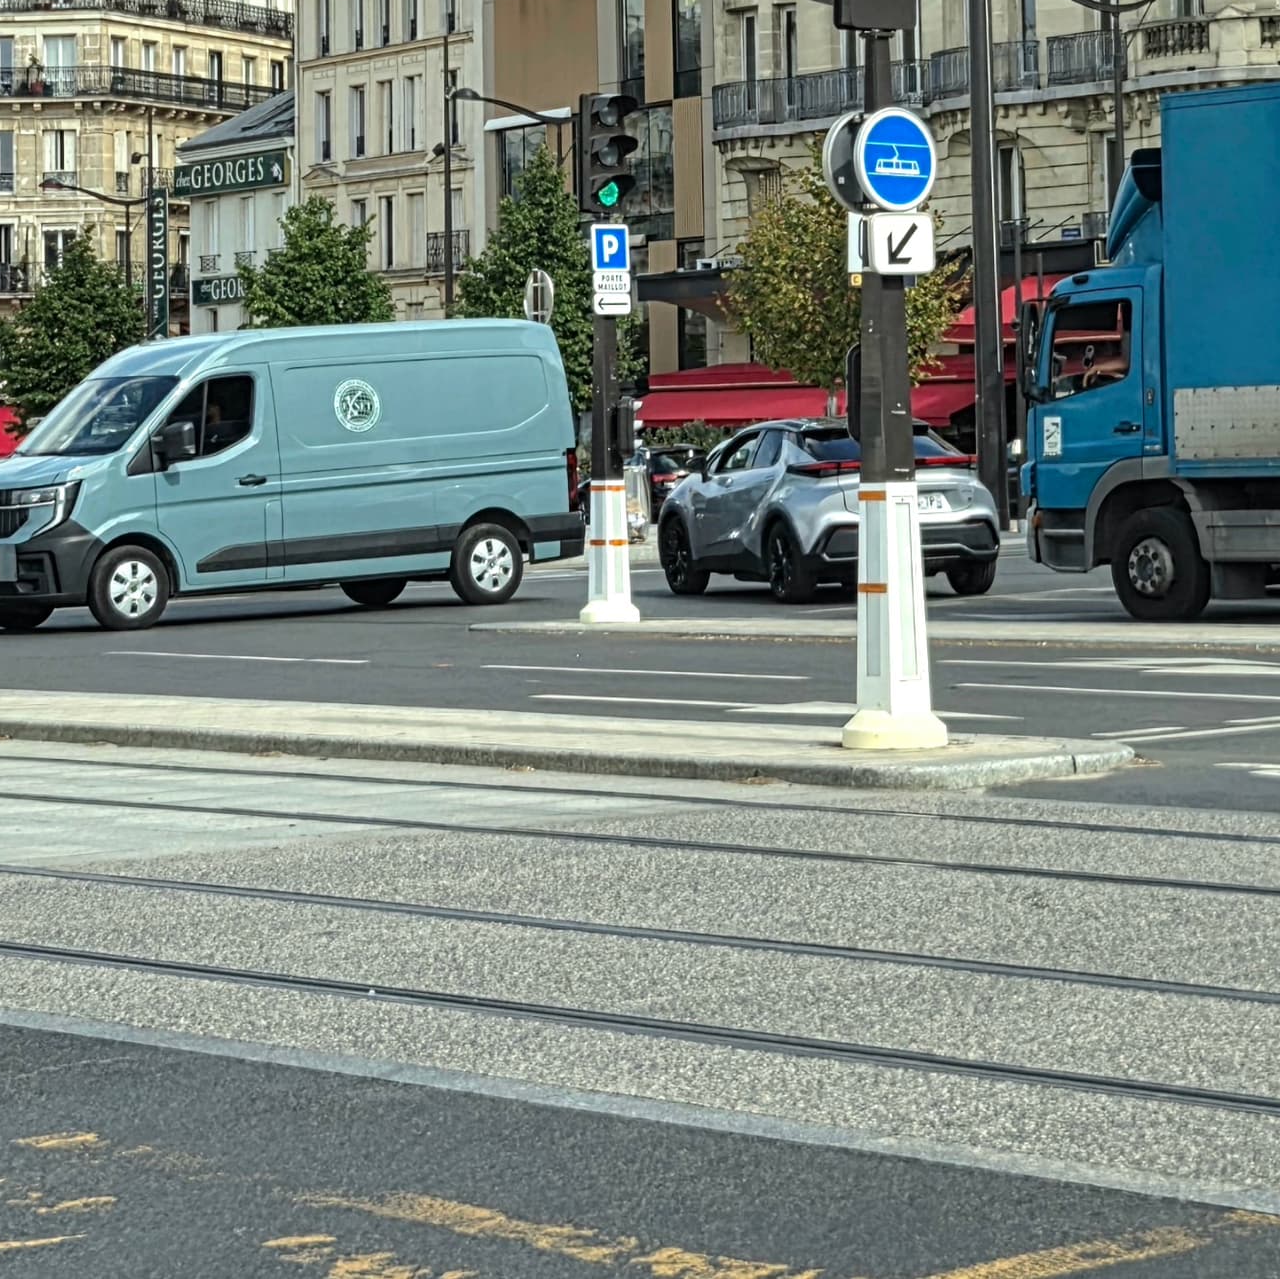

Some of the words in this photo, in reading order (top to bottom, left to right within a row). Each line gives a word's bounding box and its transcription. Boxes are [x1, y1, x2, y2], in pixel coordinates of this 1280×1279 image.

[191, 157, 264, 189] GEORGES
[602, 234, 618, 263] P
[211, 278, 245, 300] GEOR
[598, 283, 627, 291] MAILLOT
